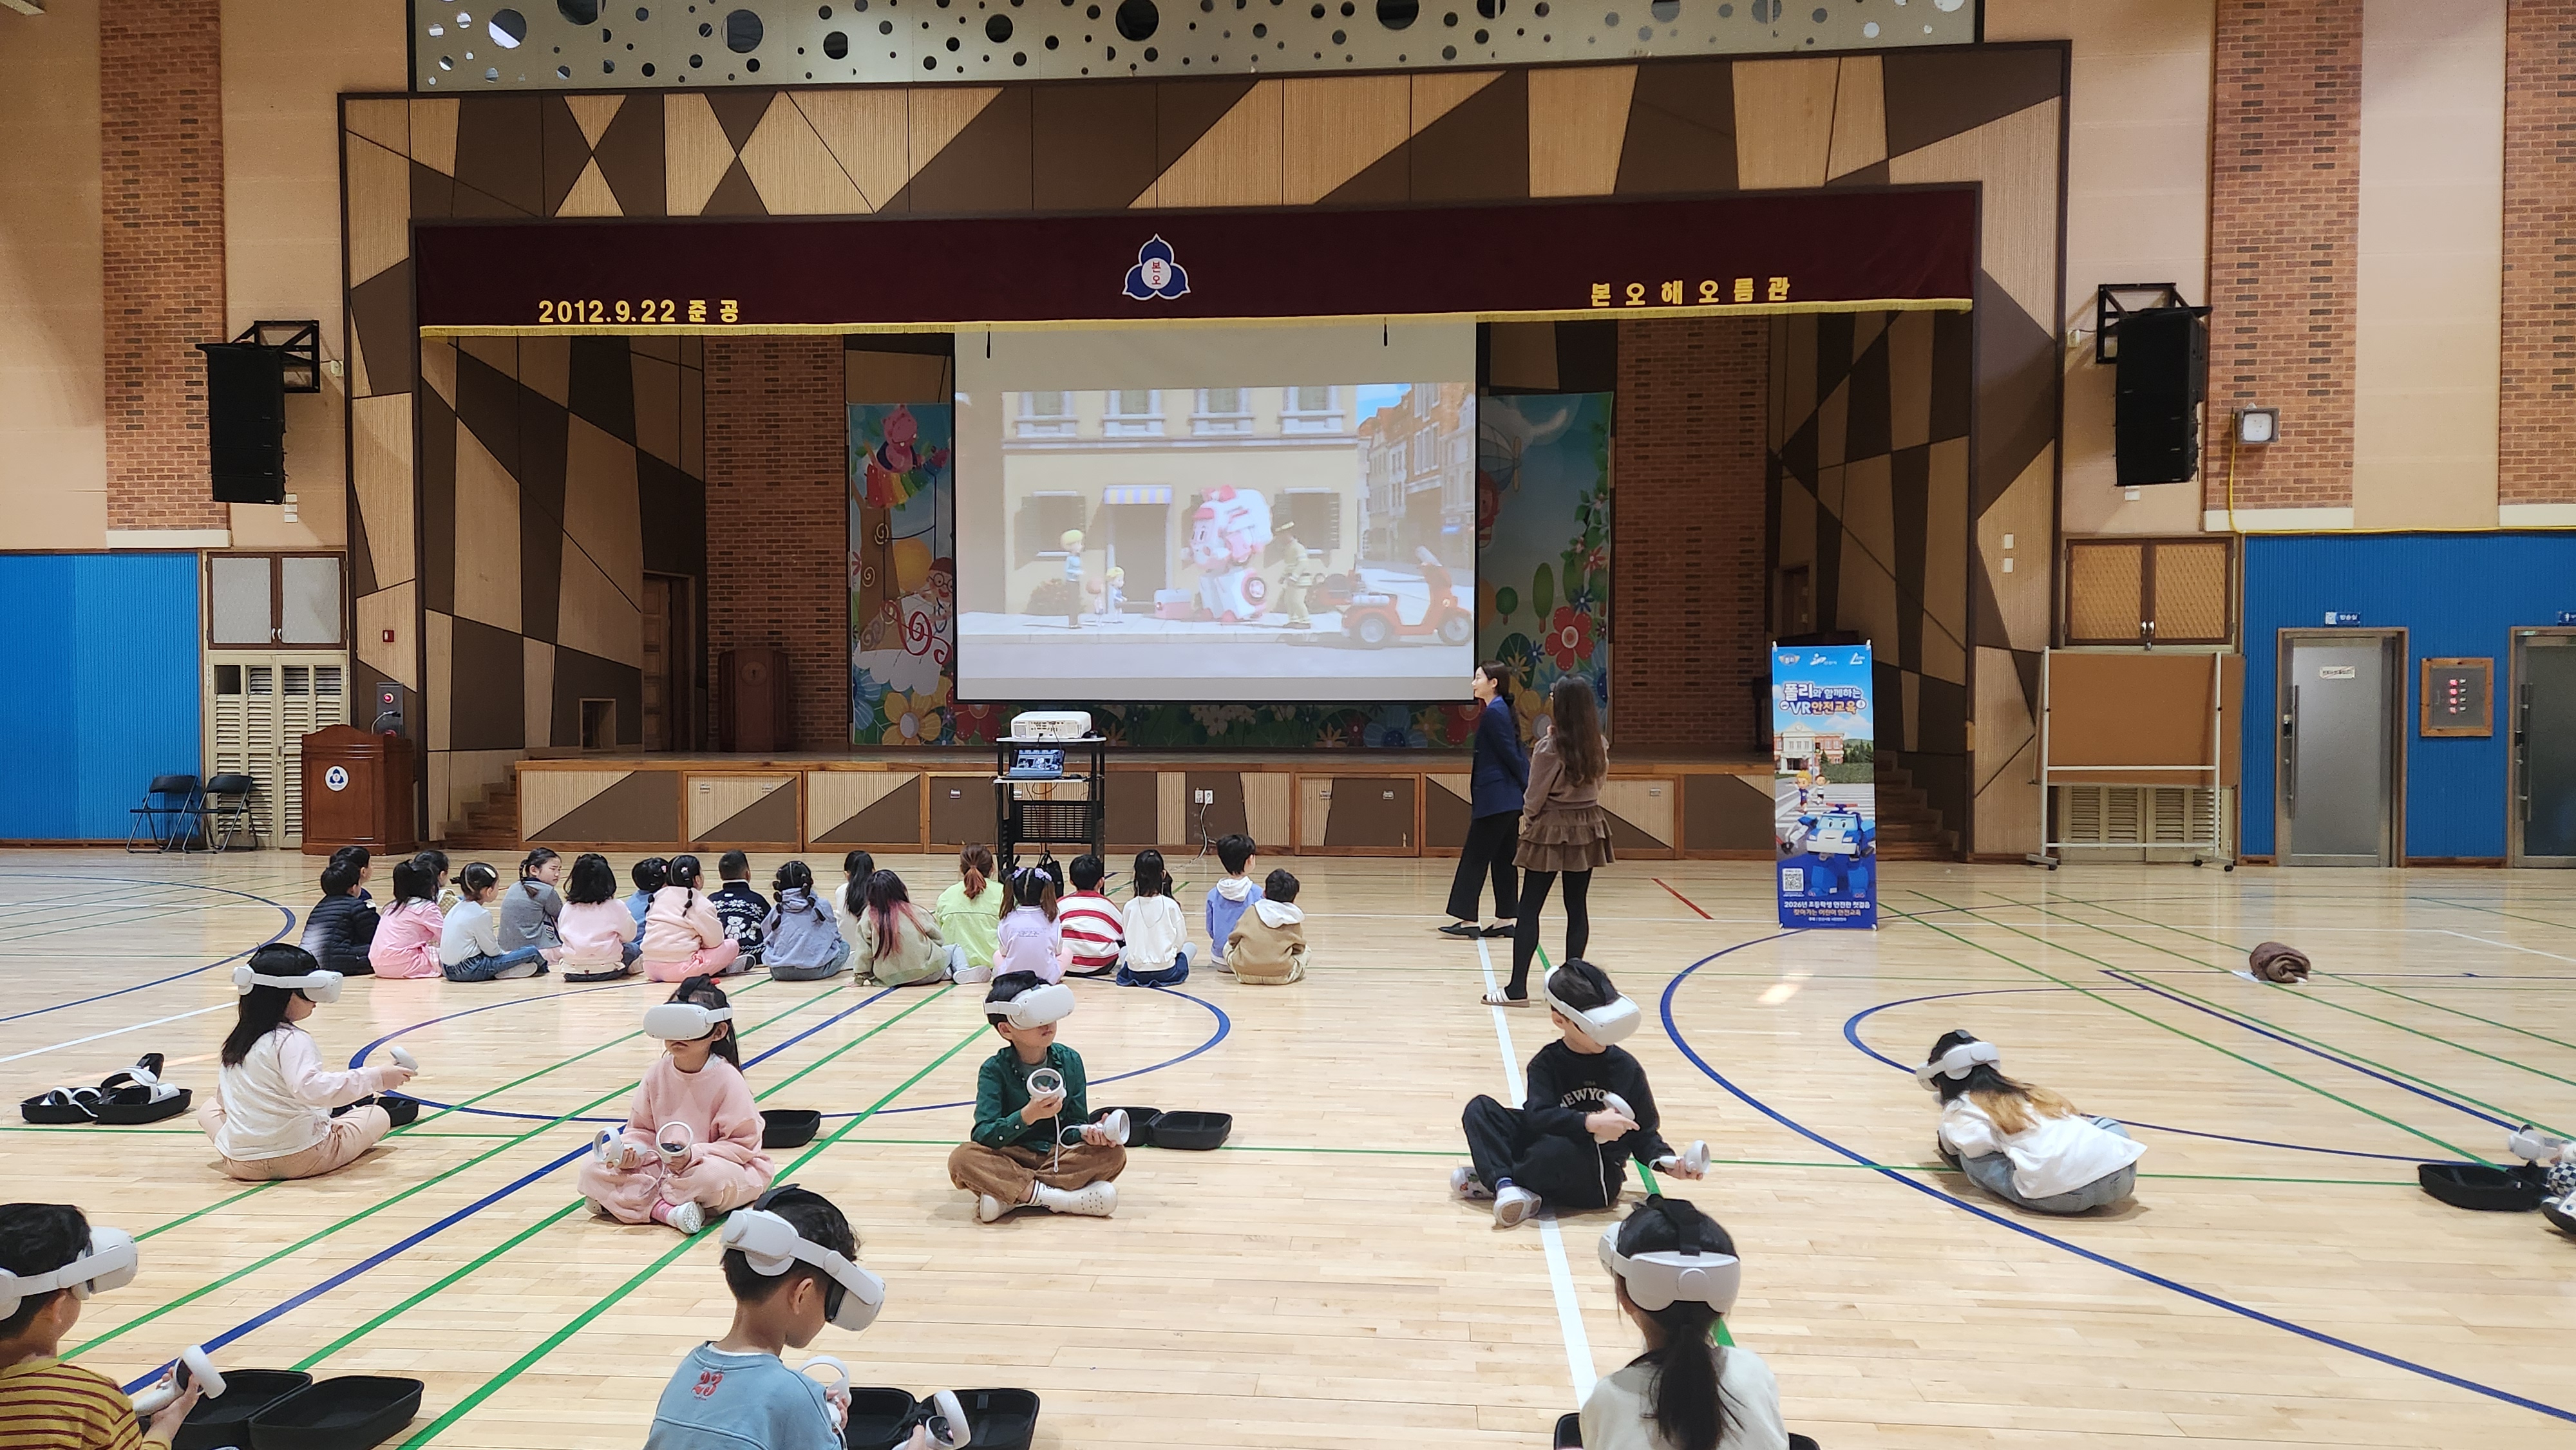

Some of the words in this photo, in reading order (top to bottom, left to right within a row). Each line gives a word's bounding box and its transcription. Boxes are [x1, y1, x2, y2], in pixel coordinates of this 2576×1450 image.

[1151, 261, 1161, 285] 본오
[539, 299, 675, 323] 2012.9.22
[688, 299, 739, 323] 준공
[1784, 683, 1822, 701] 폴리와
[1824, 688, 1862, 699] 함께하는
[1790, 701, 1856, 715] VR안전교육
[1560, 1088, 1608, 1108] NEWYO
[691, 1371, 723, 1397] 23
